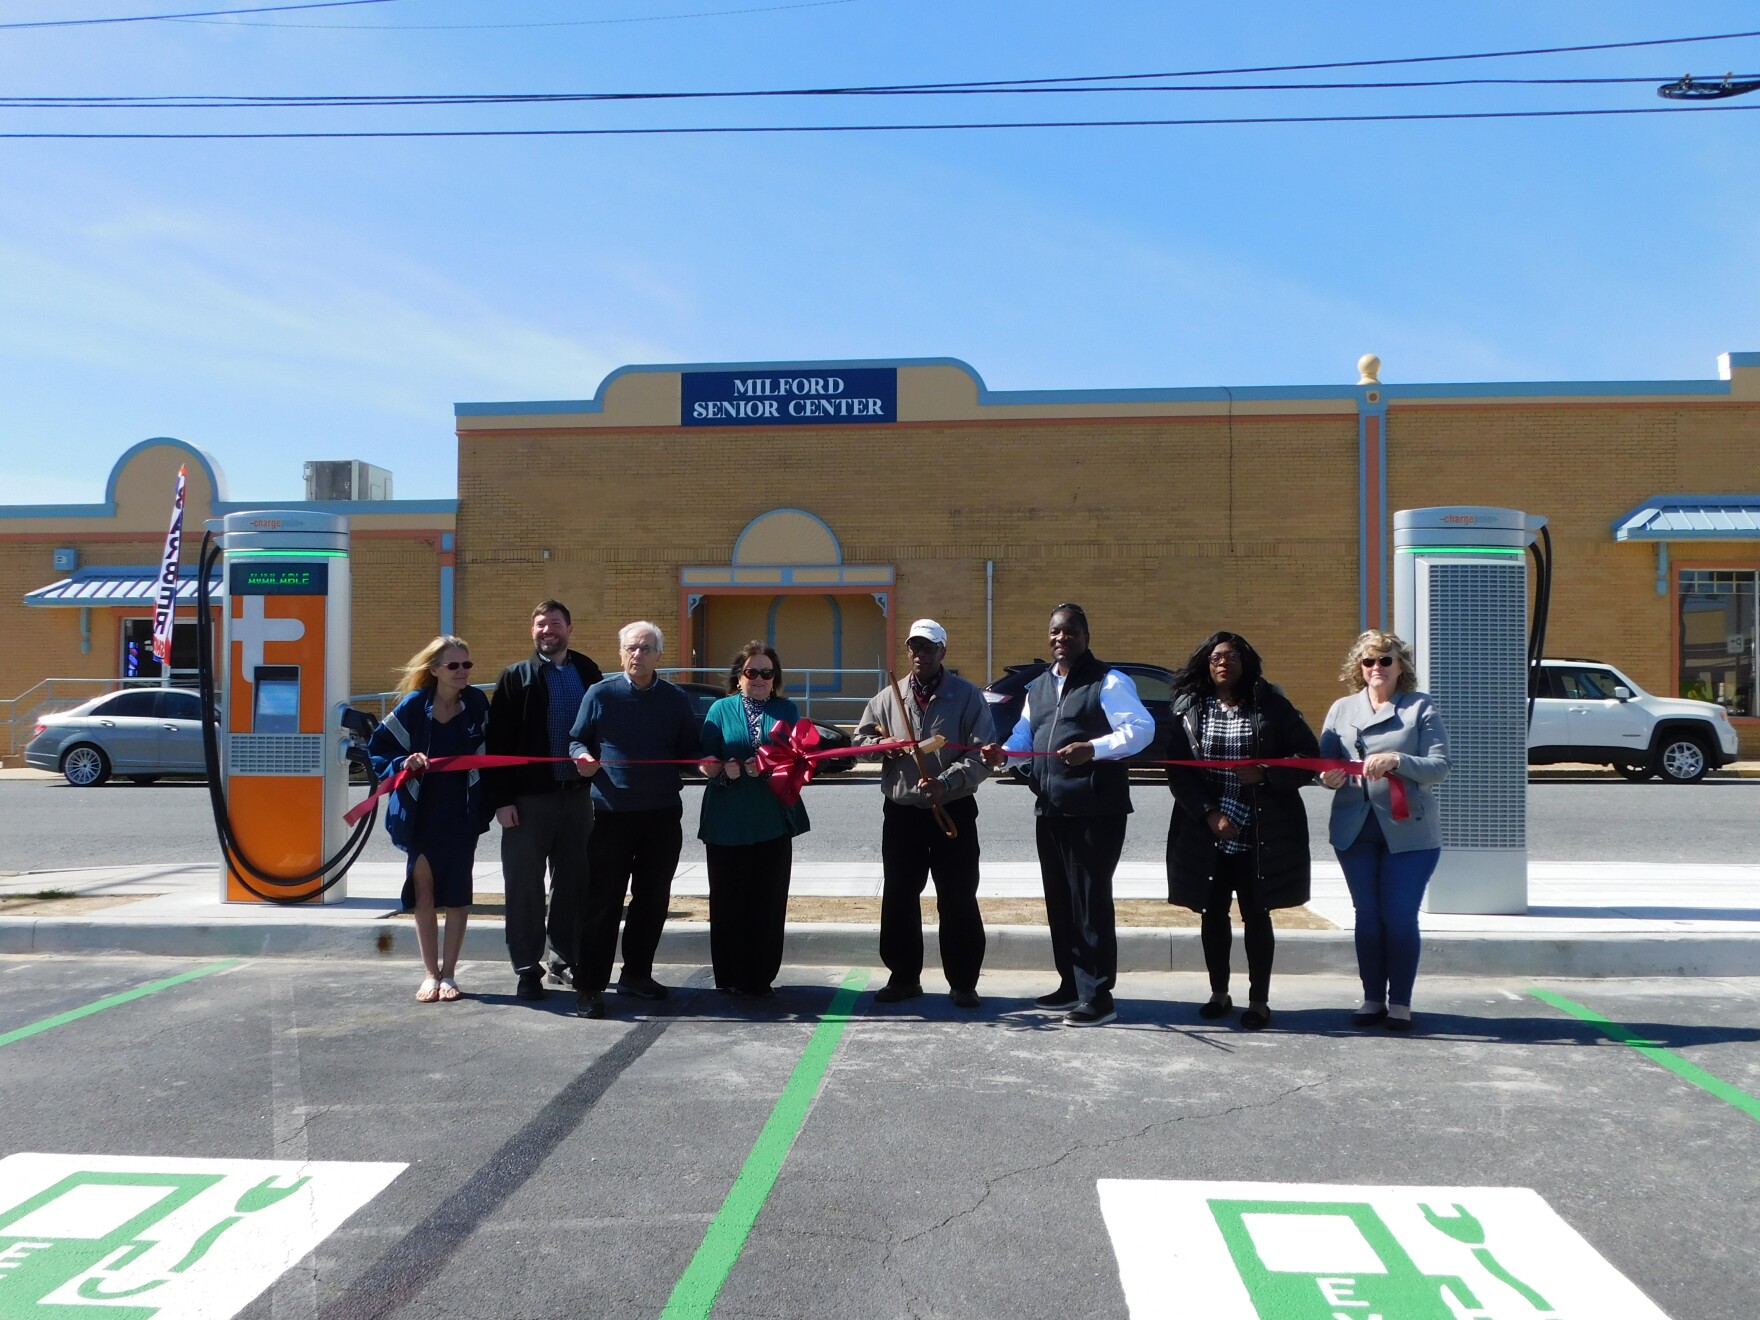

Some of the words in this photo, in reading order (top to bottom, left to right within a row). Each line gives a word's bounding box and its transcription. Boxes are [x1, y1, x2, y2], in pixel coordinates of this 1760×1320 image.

[733, 377, 845, 396] MILFORD
[692, 400, 780, 419] SENIOR
[788, 398, 885, 417] CENTER
[247, 572, 310, 585] AVAILABLE
